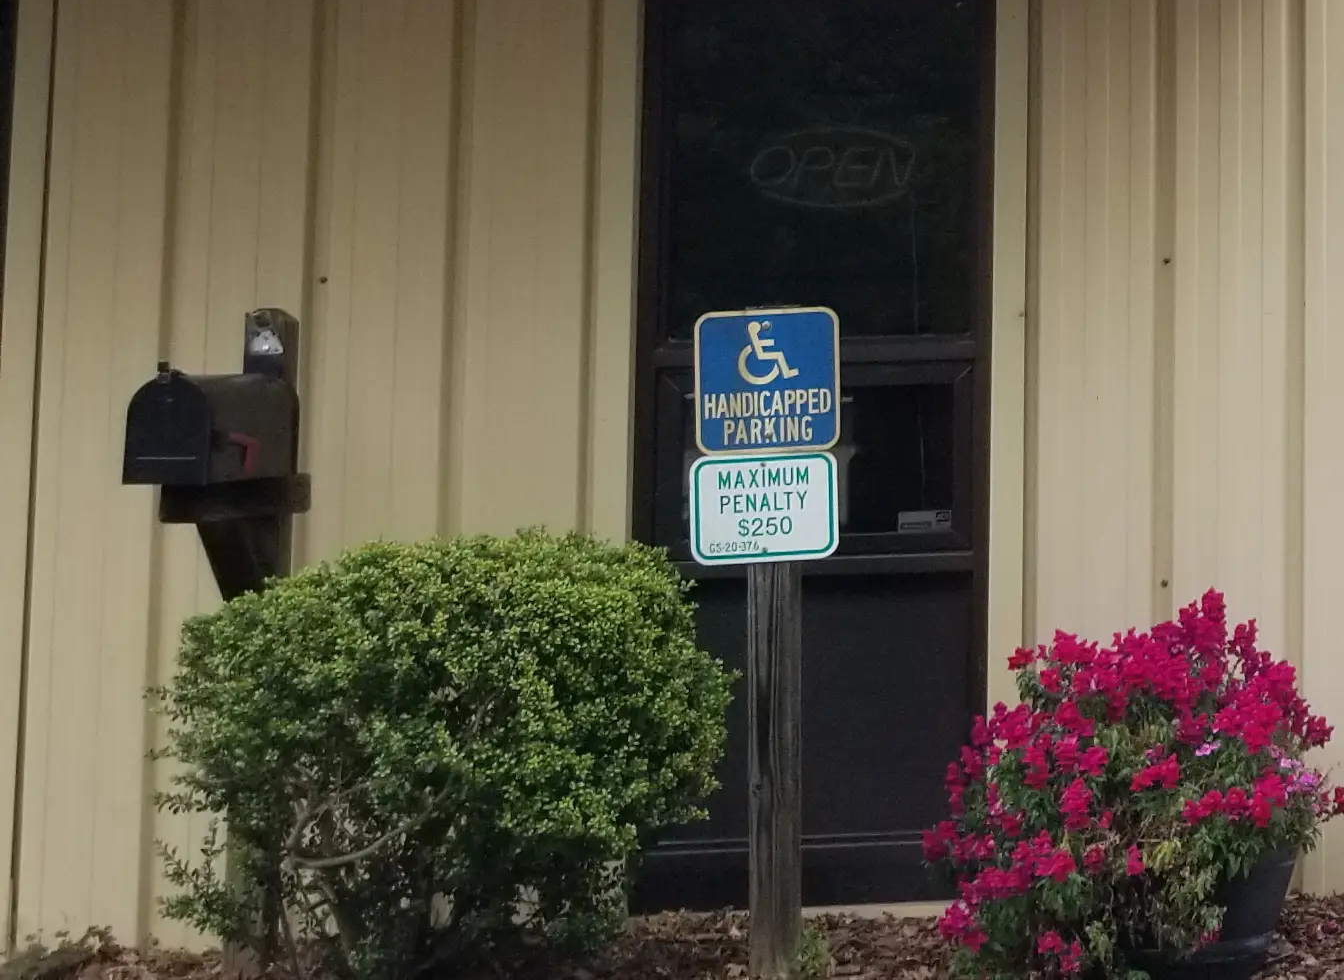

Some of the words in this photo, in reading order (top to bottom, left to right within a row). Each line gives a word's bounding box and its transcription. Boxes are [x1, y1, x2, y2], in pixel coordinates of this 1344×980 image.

[750, 145, 916, 188] OPEN
[704, 388, 832, 420] HANDICAPPED
[723, 415, 813, 446] PARKING
[718, 465, 809, 490] MAXIMUM
[719, 490, 808, 514] PENALTY
[738, 515, 793, 537] $250
